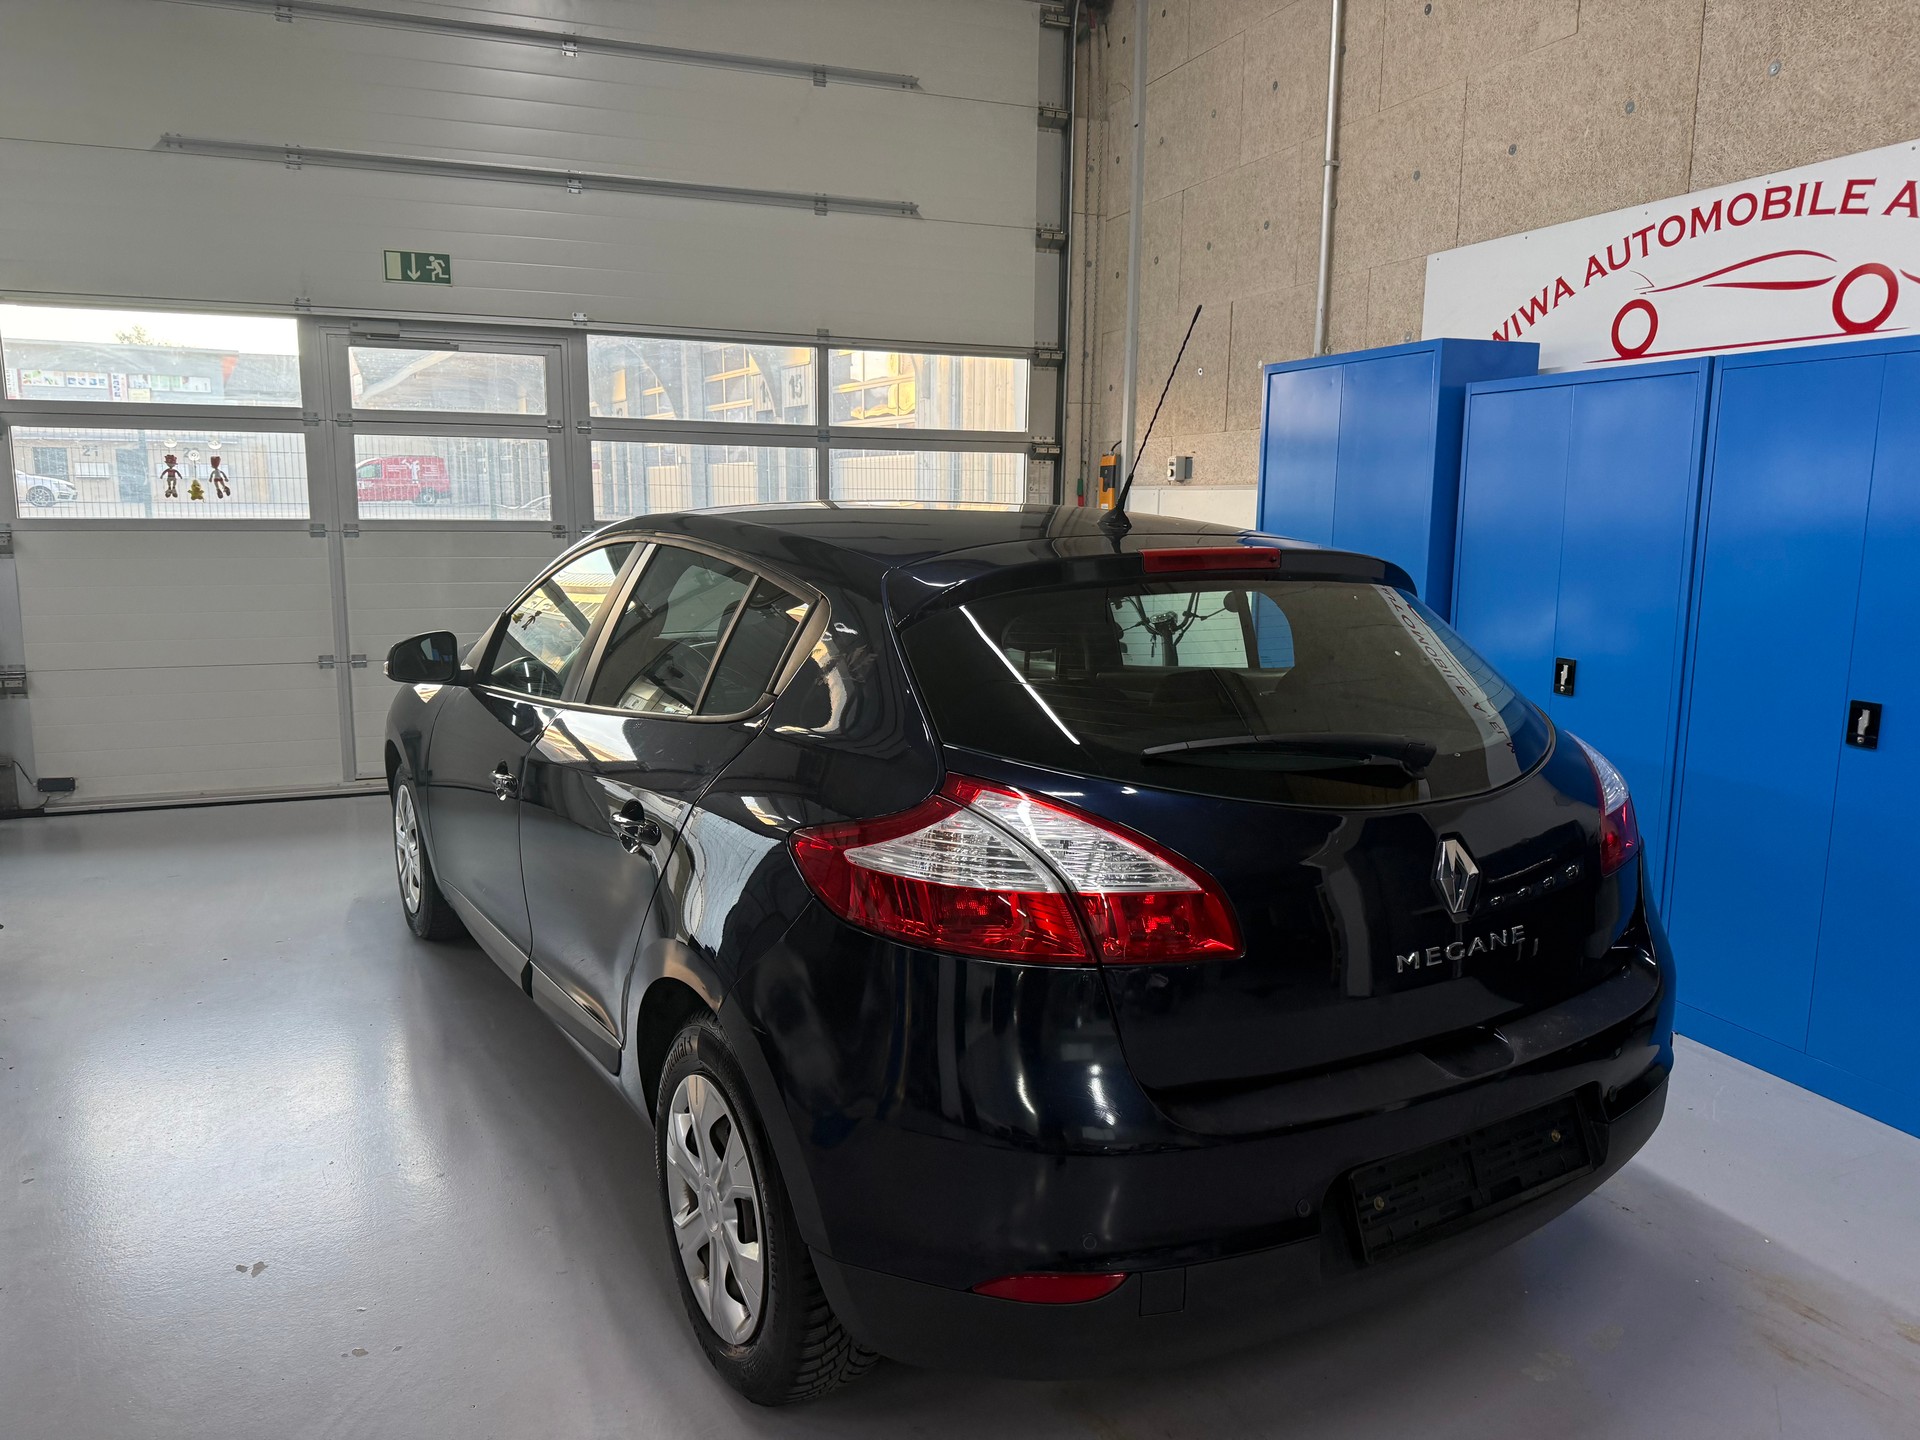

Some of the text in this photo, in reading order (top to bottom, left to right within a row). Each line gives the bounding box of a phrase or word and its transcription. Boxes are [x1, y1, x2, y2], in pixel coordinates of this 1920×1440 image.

[1583, 176, 1878, 289] AUTOMOBILE
[788, 373, 803, 400] 15
[1396, 924, 1526, 974] MEGANE
